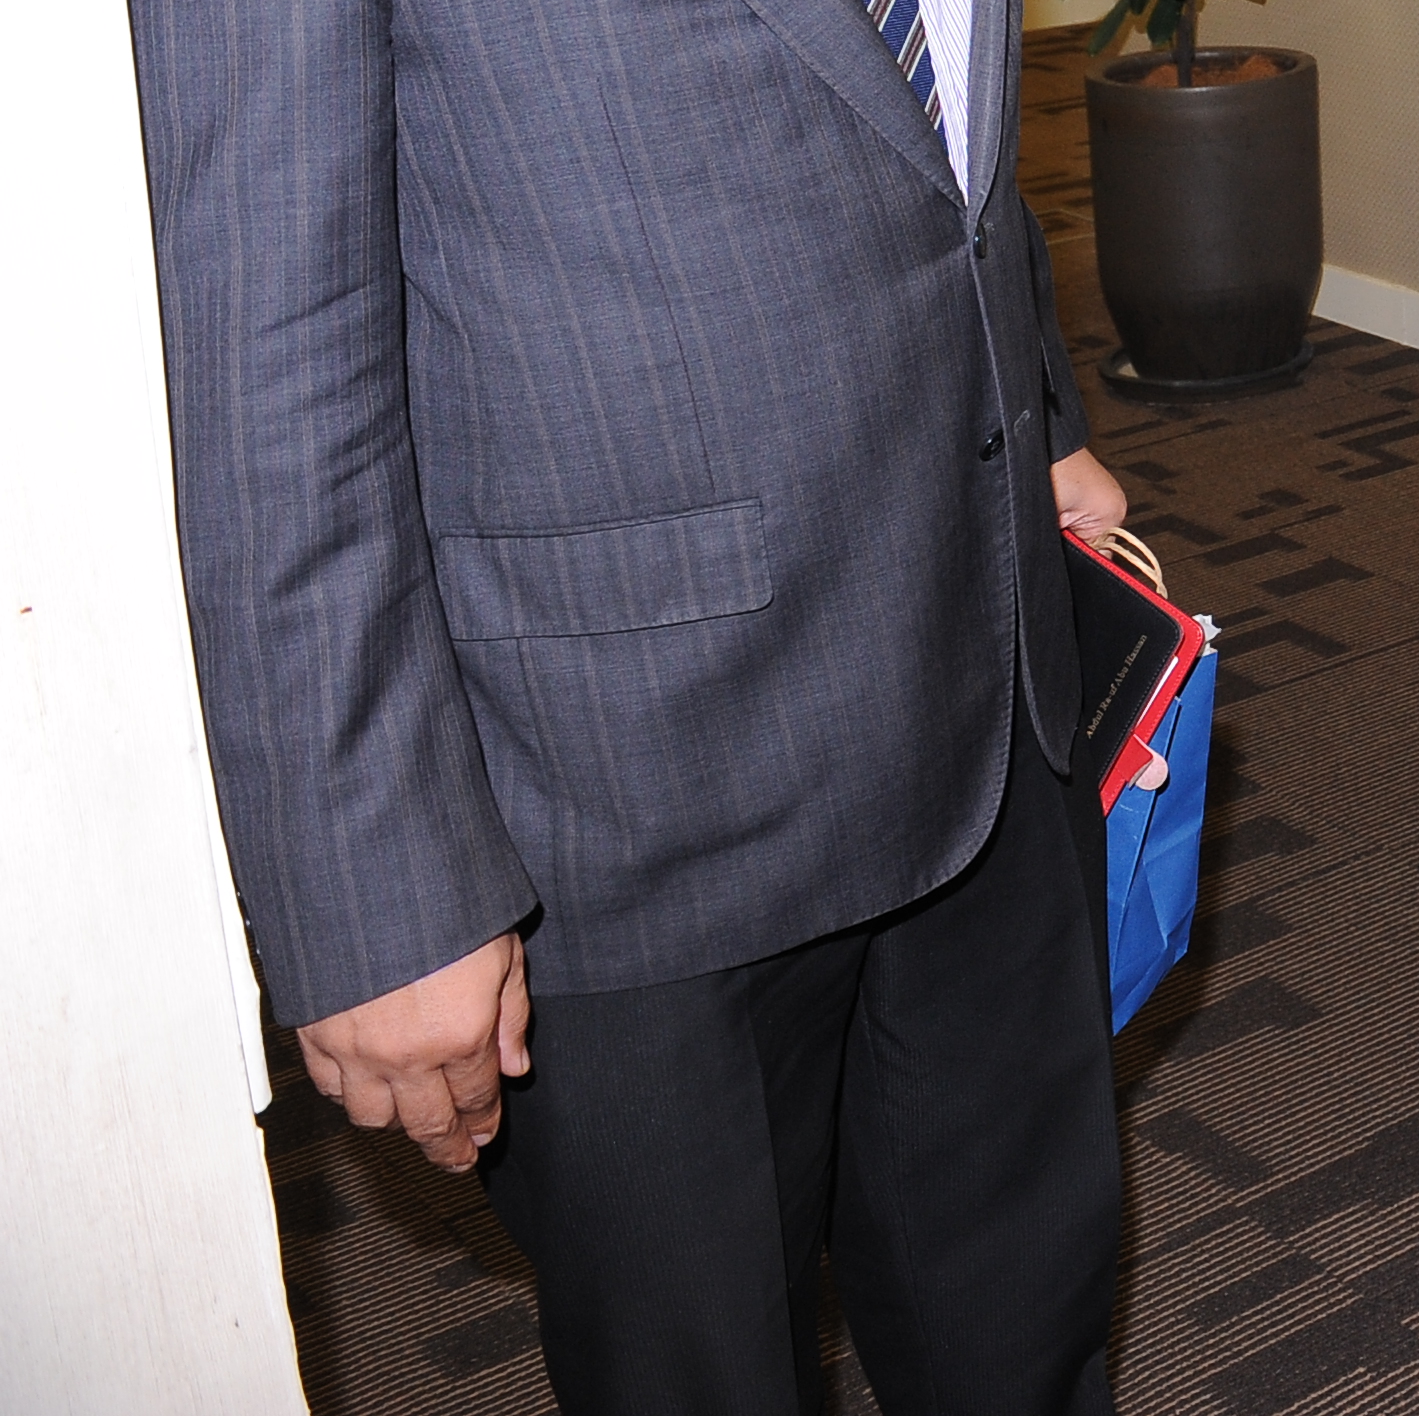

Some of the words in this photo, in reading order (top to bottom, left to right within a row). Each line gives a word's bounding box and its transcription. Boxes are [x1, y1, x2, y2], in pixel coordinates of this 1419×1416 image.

[1086, 709, 1104, 739] Abdul
[1114, 666, 1129, 686] Abu
[1124, 634, 1148, 666] Hassan
